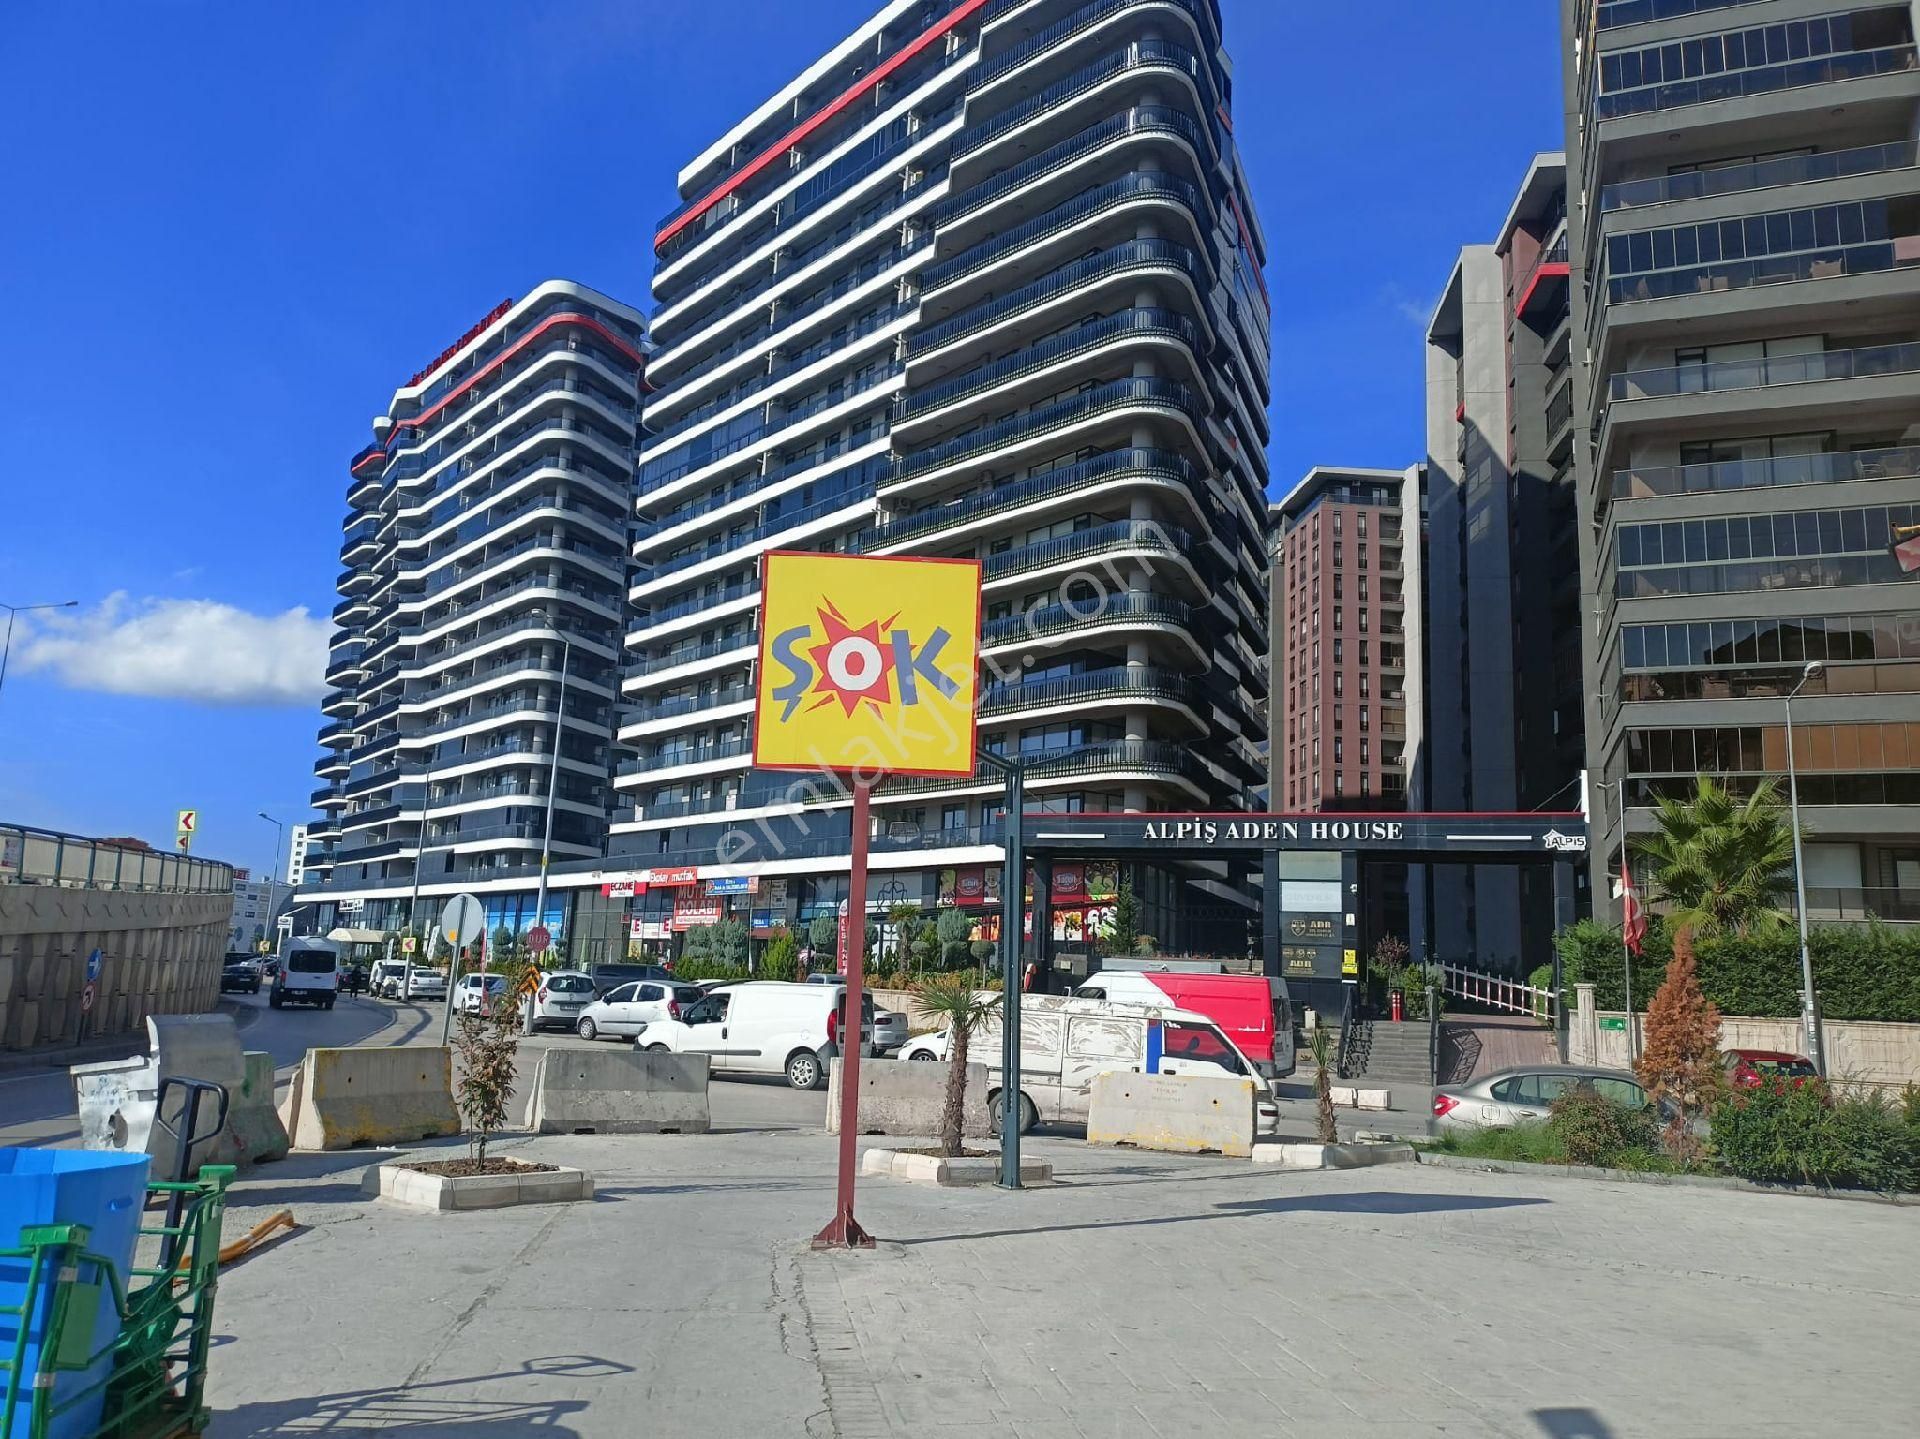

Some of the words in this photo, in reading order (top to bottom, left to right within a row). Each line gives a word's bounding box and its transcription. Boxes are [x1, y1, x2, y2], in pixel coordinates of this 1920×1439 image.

[771, 624, 961, 724] ŞOK
[1143, 817, 1218, 844] ALPİŞ
[1225, 822, 1299, 840] ADEN
[1310, 822, 1403, 840] HOUSE
[528, 934, 548, 944] DUR
